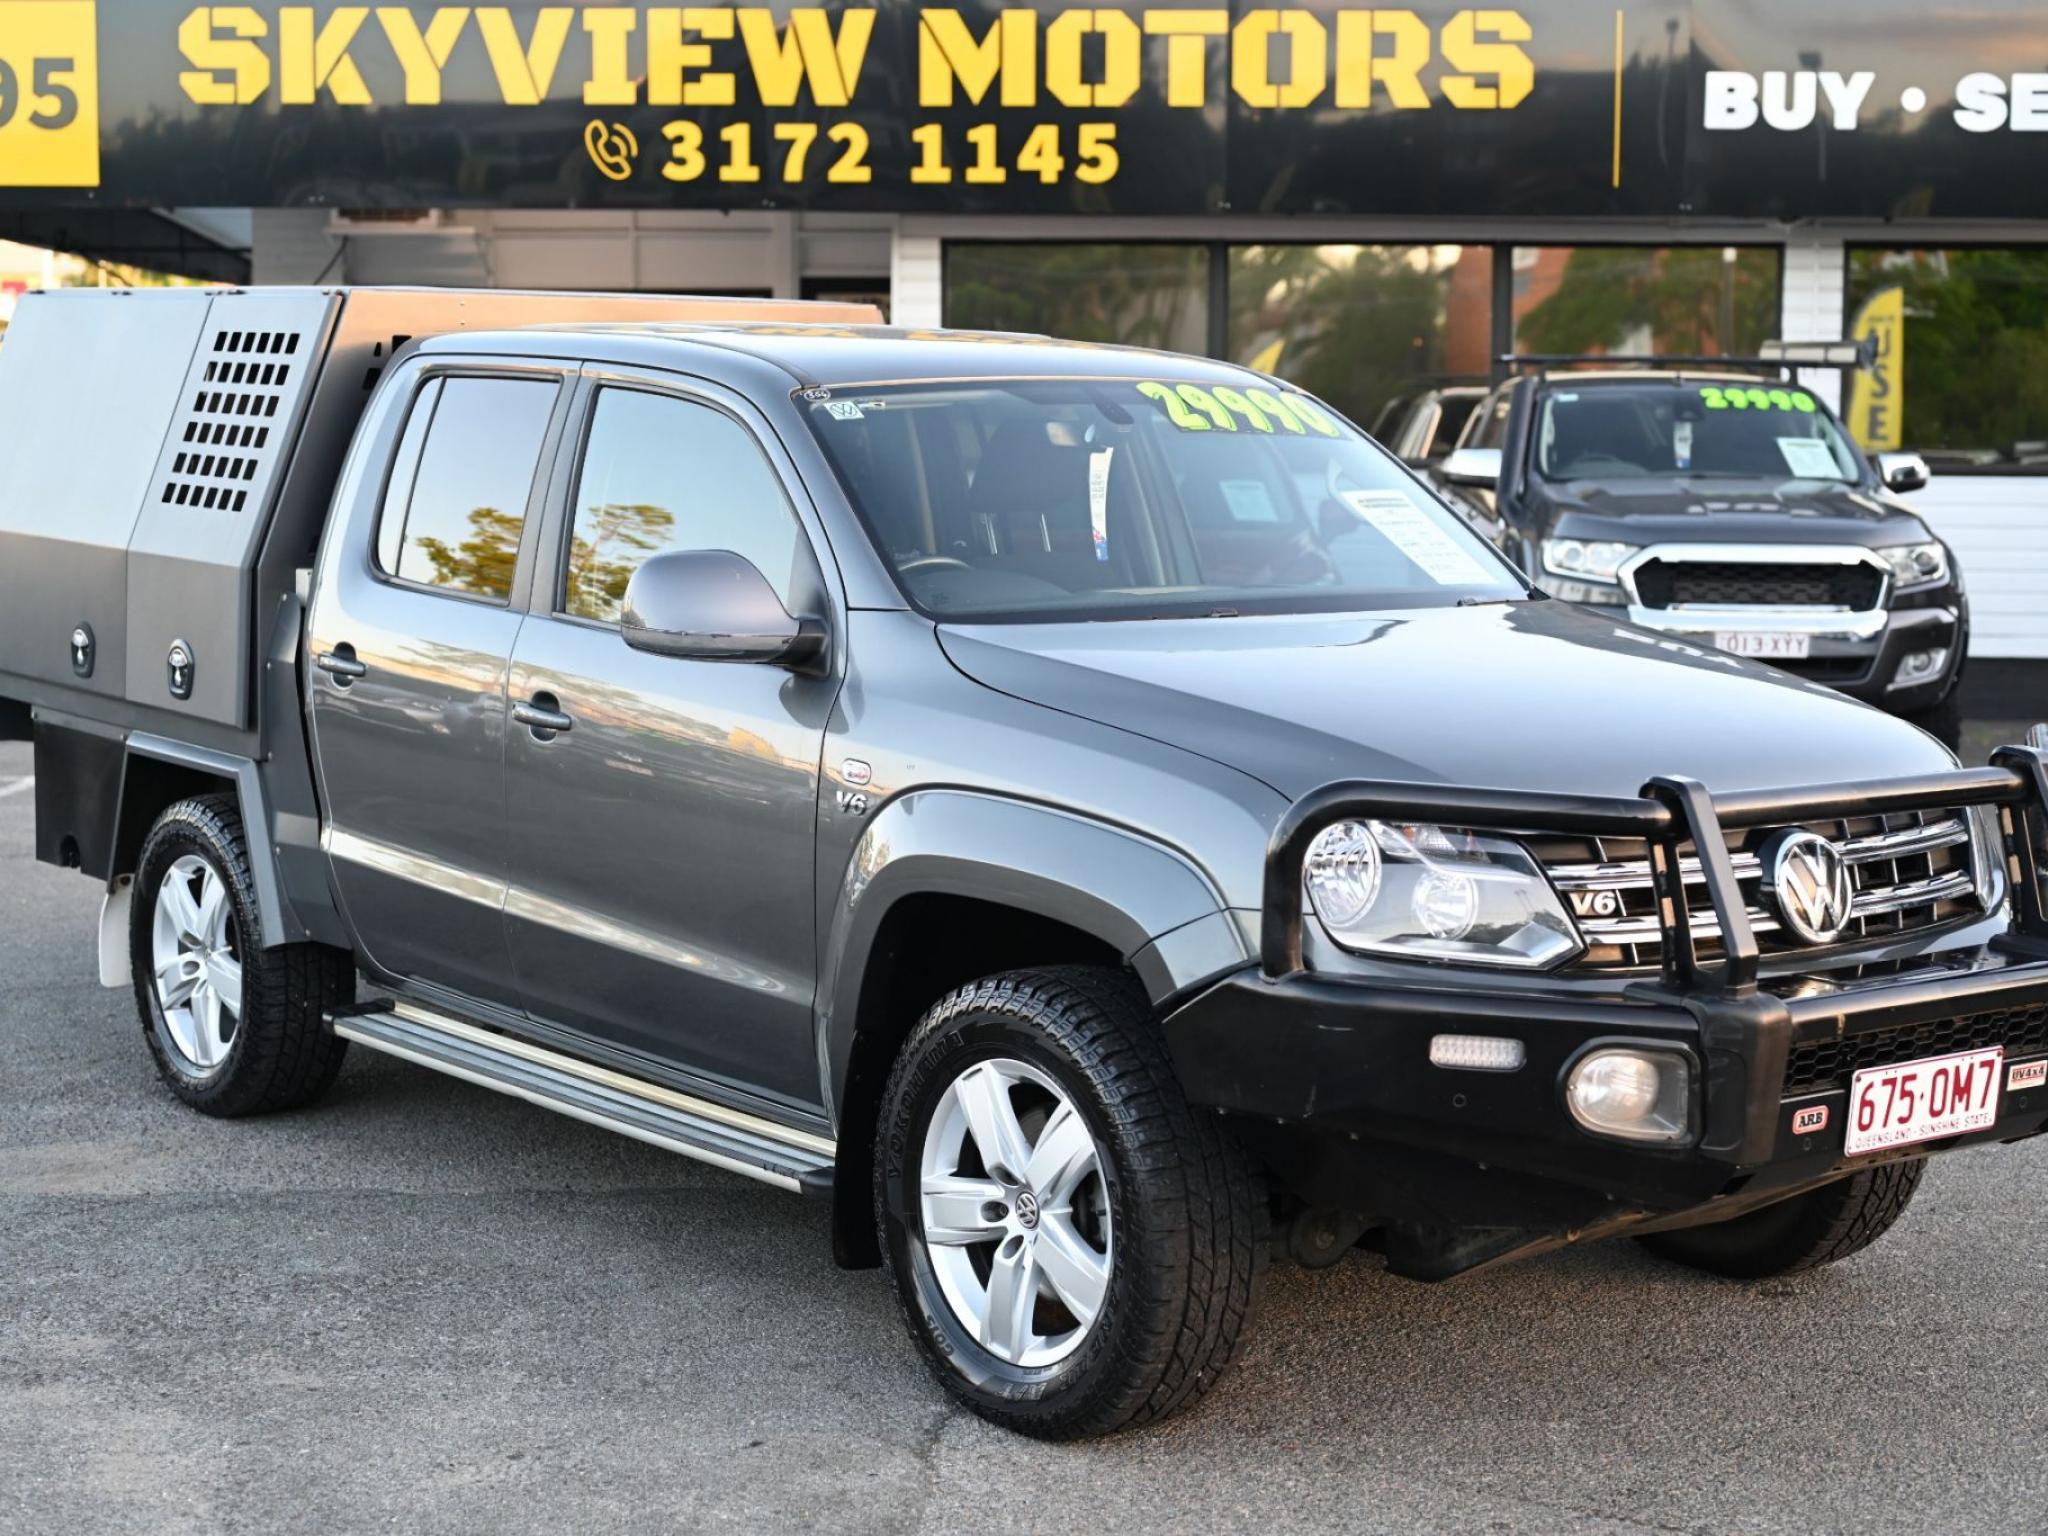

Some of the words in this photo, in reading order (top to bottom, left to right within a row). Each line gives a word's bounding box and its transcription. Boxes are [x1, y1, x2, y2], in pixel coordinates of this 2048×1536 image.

[179, 7, 877, 106] SKYVIEW
[919, 8, 1536, 109] MOTORS
[1704, 71, 1875, 130] BUY
[661, 120, 872, 183] 3172
[911, 123, 1119, 184] 1145
[1136, 381, 1341, 437] 29990
[1699, 387, 1816, 414] 29990
[836, 790, 868, 816] V6
[1570, 890, 1617, 916] V6
[1799, 1112, 1824, 1128] ARB
